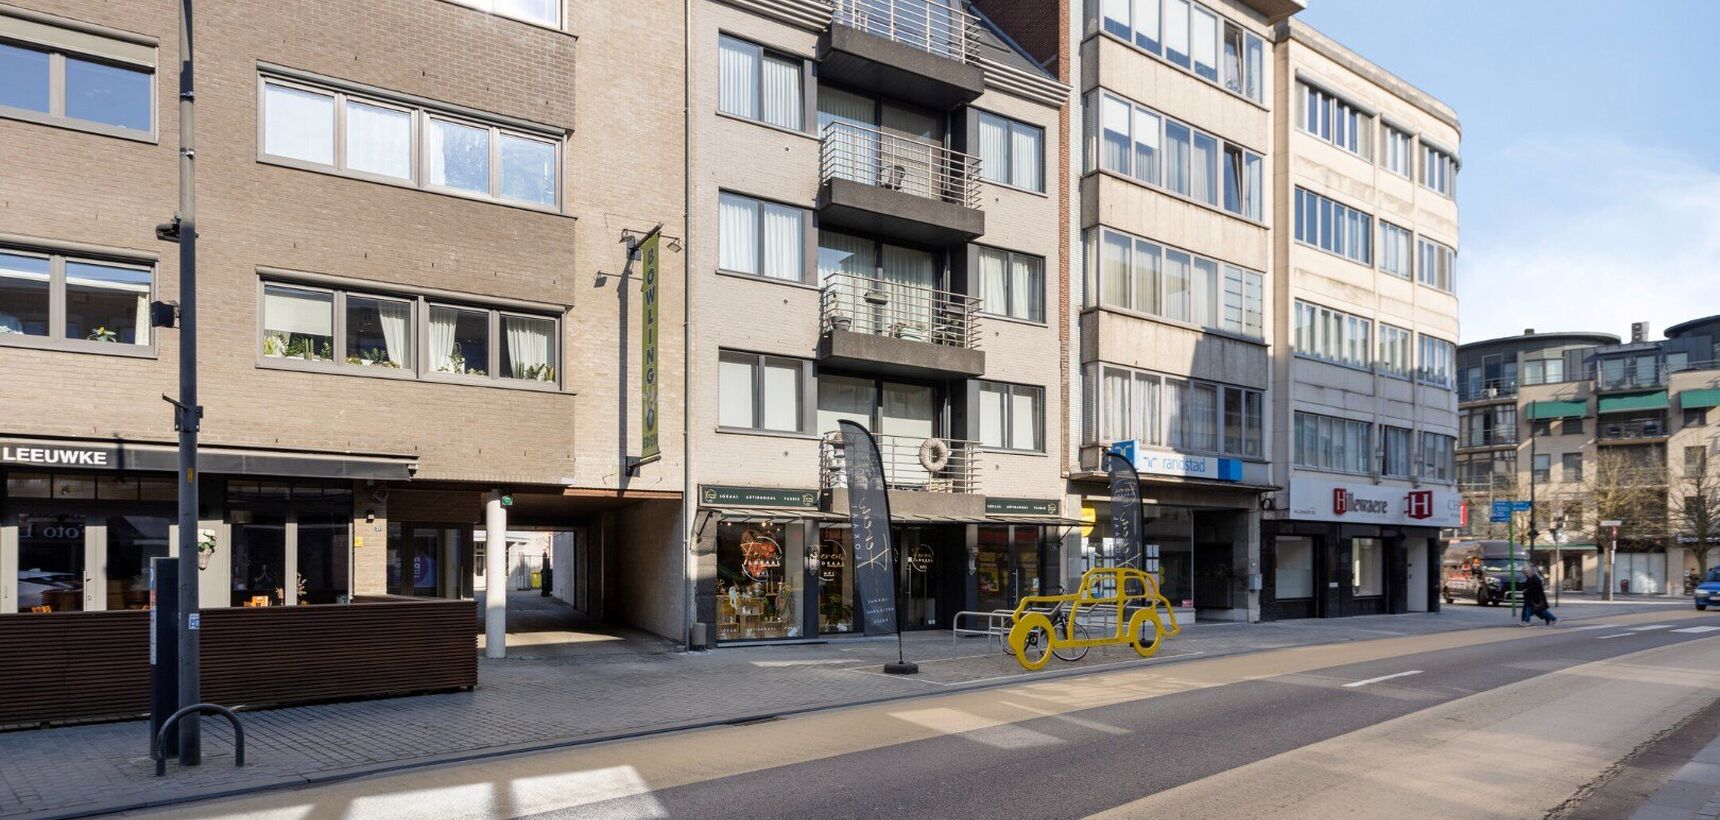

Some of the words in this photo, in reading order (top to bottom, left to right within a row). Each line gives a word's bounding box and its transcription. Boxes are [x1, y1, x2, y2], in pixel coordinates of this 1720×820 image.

[645, 246, 656, 386] BOWLING
[2, 446, 107, 465] LEEUWKE
[1162, 457, 1206, 473] randstad
[1337, 490, 1388, 514] Hillewaere
[1411, 494, 1429, 516] H
